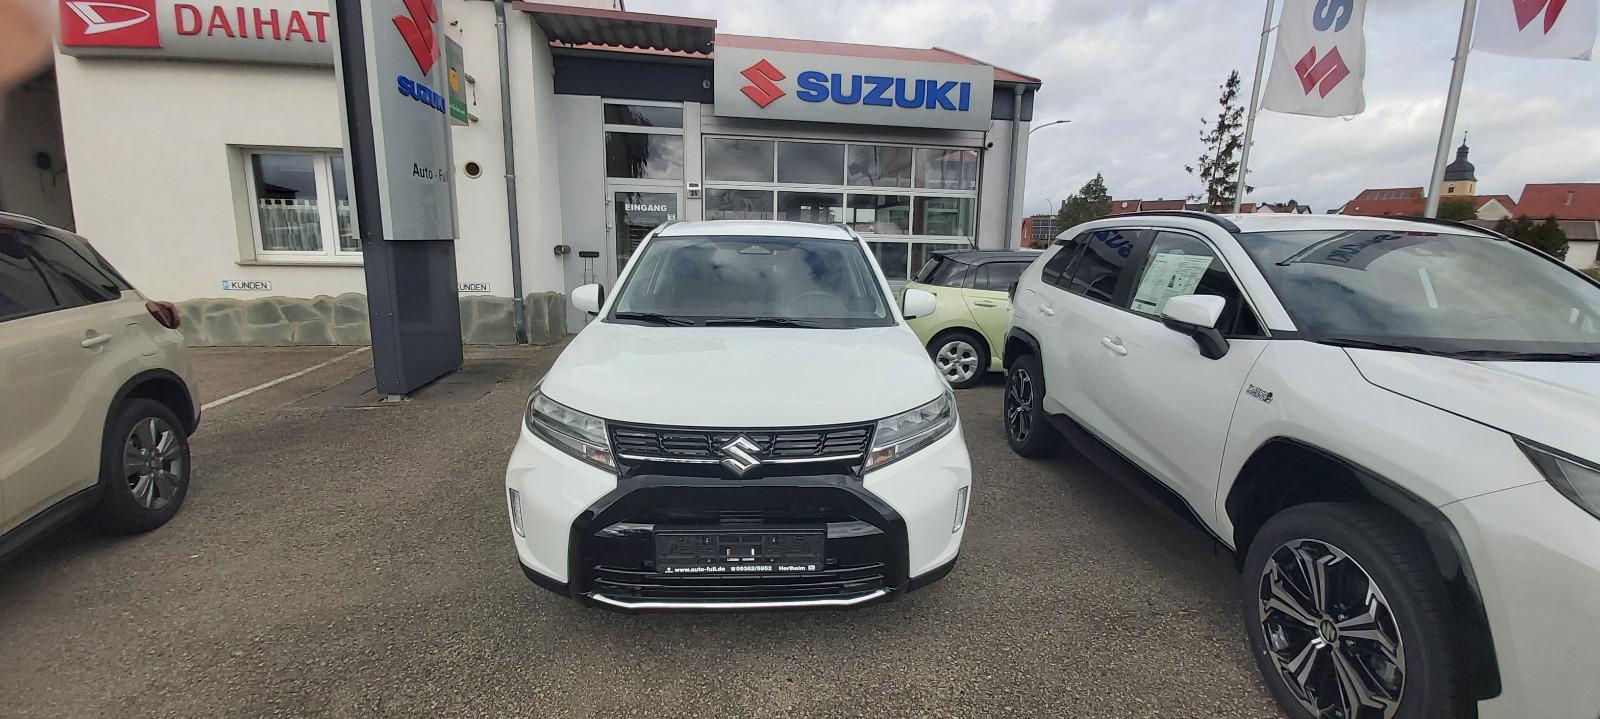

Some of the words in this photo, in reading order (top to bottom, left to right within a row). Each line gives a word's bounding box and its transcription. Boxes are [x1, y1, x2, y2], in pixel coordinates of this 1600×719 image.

[796, 70, 971, 112] SUZUKI
[412, 162, 433, 180] Auto
[624, 203, 668, 212] EINGANG
[231, 281, 268, 289] KUNDEN
[457, 283, 487, 291] UNDEN
